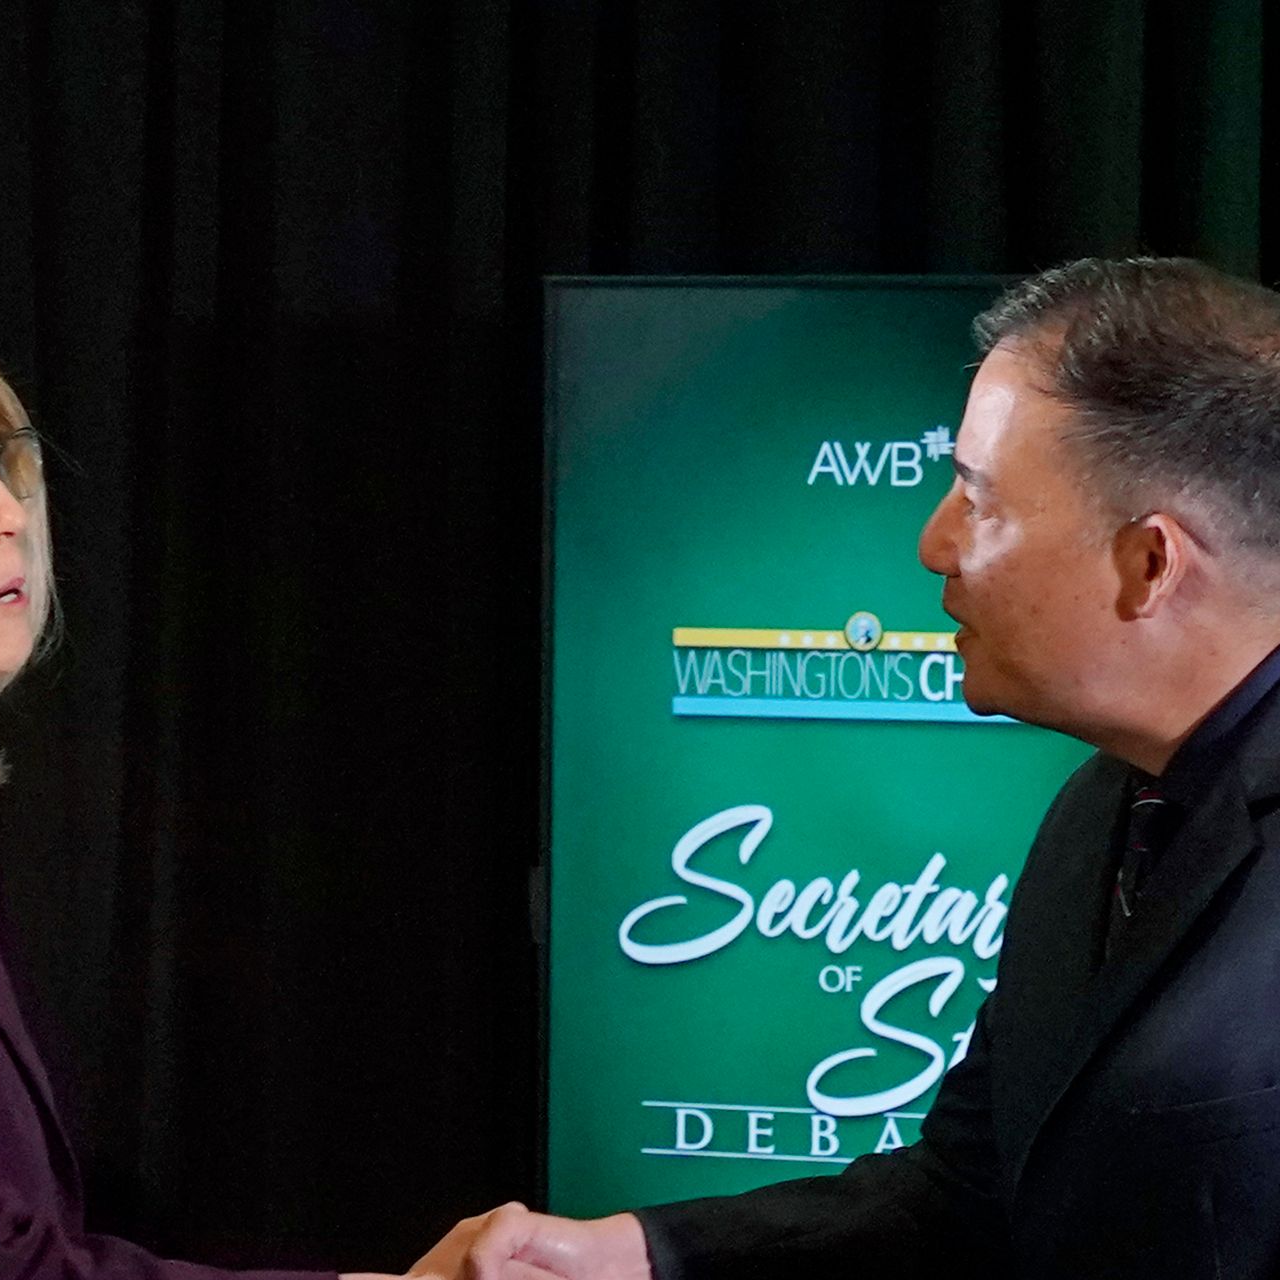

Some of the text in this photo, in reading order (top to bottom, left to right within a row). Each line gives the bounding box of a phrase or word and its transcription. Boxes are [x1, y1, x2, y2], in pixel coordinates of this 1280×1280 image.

[807, 441, 923, 487] AWB
[672, 650, 914, 700] WASHINGTON'S
[619, 804, 1009, 993] Secretar
[818, 965, 862, 992] OF
[675, 1108, 905, 1156] DEBA
